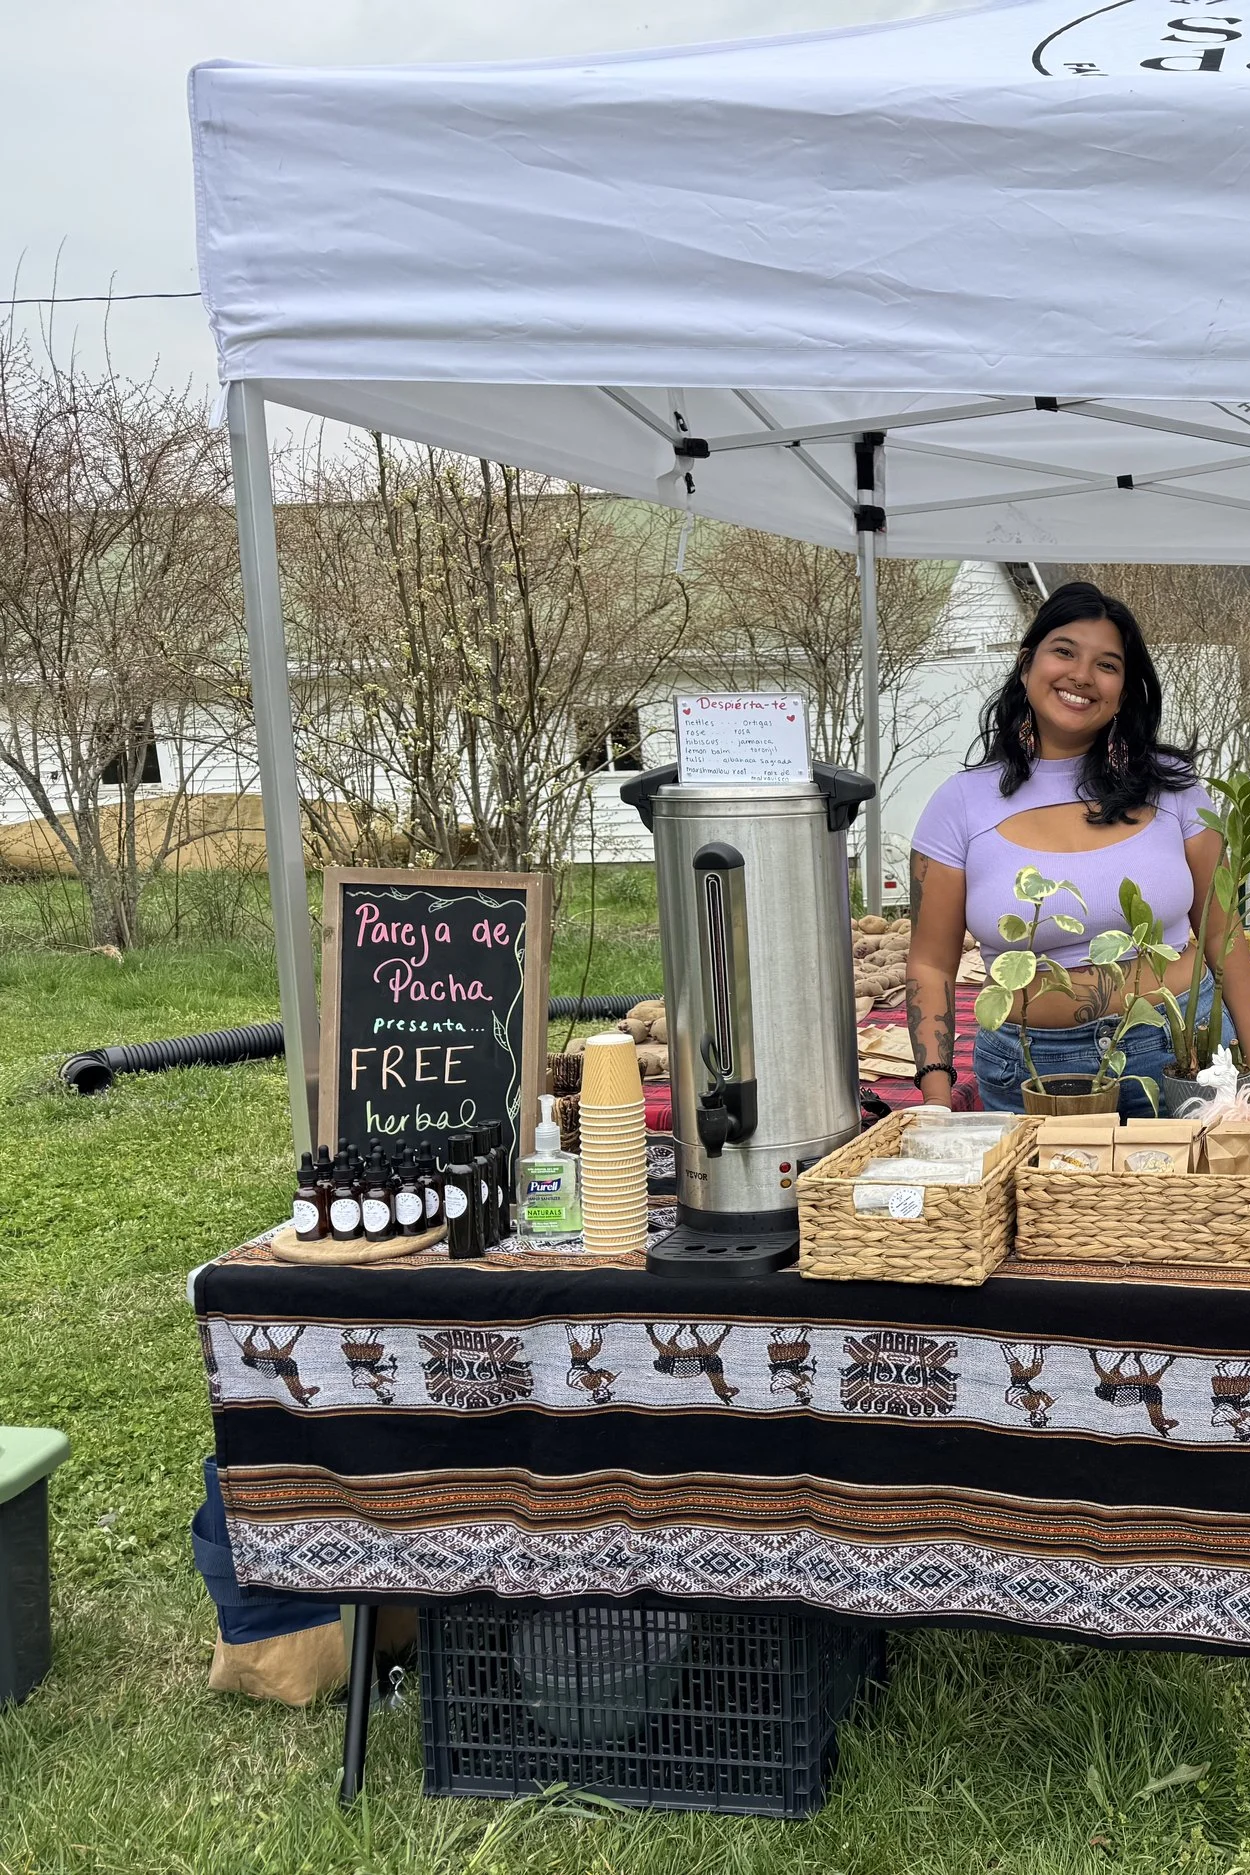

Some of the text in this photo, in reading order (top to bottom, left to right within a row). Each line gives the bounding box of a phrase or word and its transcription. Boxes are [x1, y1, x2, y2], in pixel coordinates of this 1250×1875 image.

[355, 902, 510, 968] Pareja de
[373, 958, 494, 1003] Pacha
[351, 1045, 474, 1090] FREE
[366, 1098, 478, 1134] herbal
